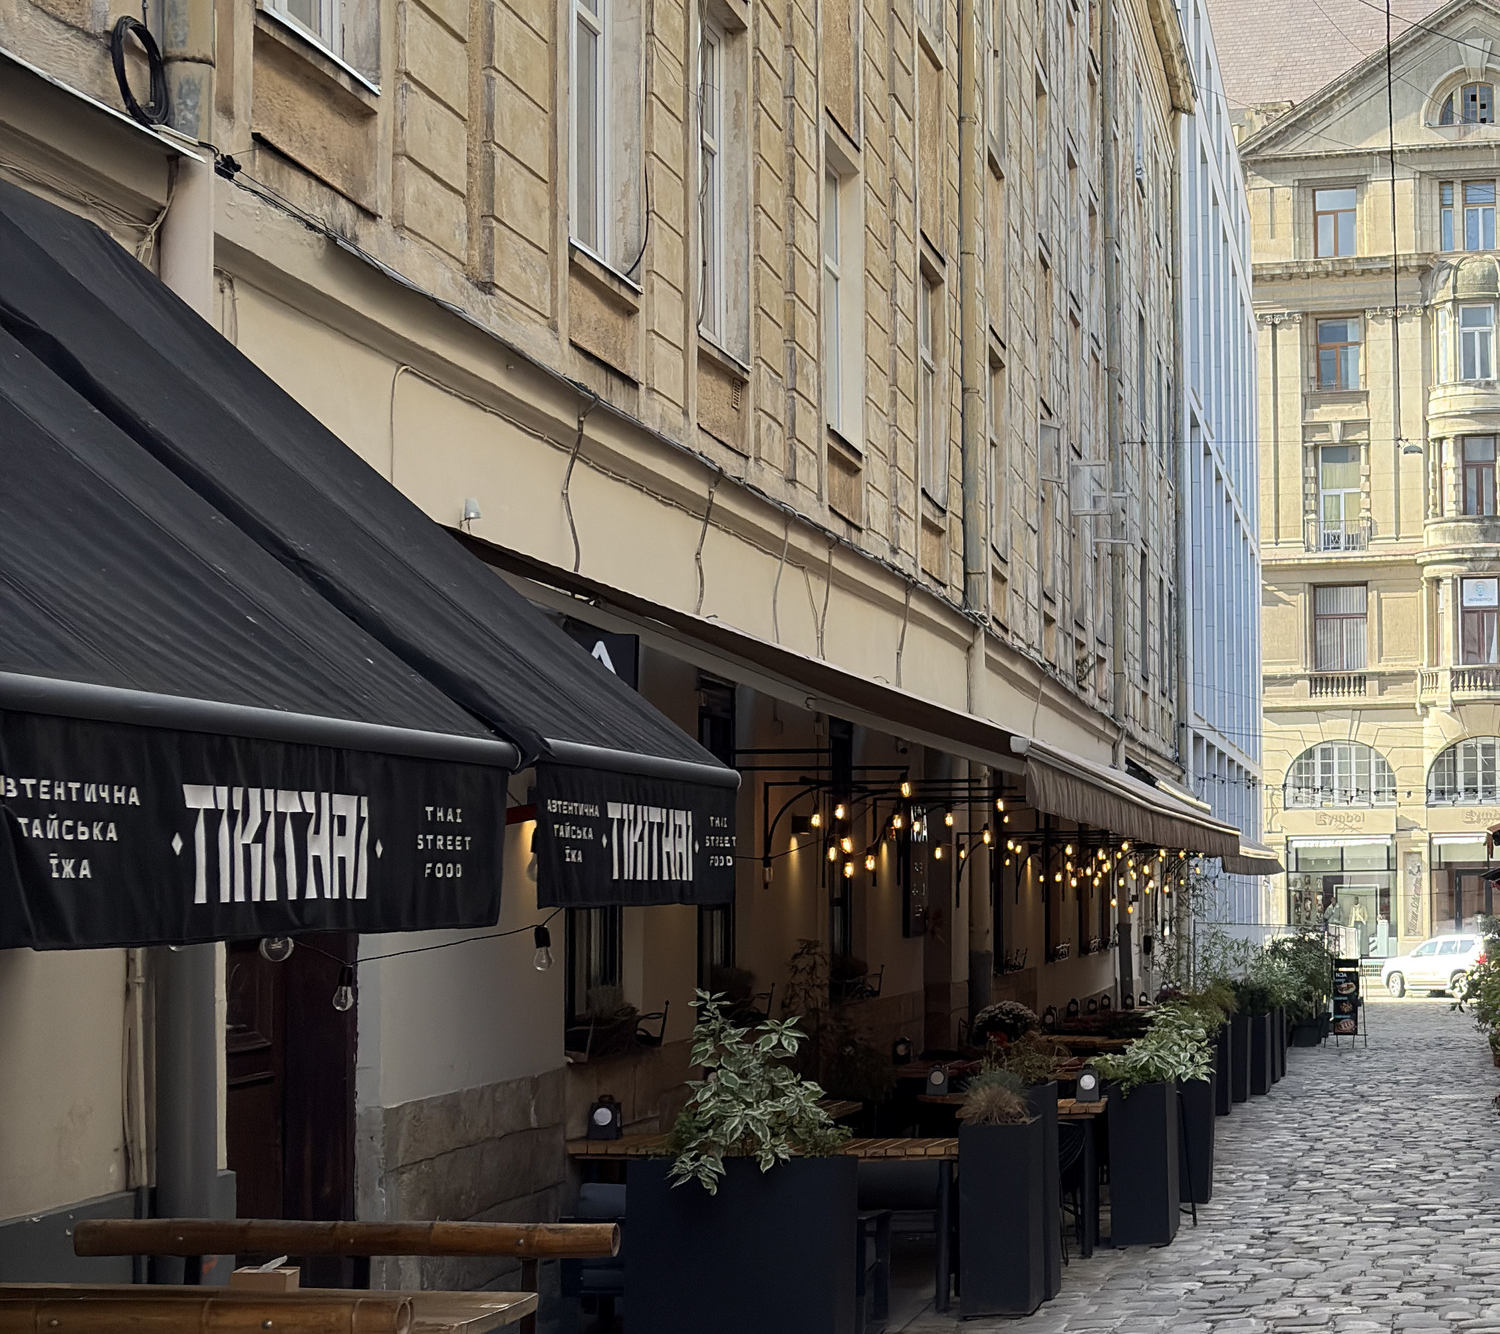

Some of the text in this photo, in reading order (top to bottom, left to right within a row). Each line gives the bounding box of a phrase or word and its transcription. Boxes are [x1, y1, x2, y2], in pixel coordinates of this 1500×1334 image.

[425, 806, 463, 823] THAI
[709, 816, 728, 828] THAI
[17, 813, 118, 842] ТАЙСЬКА
[553, 822, 594, 840] ТАЙСЬКА
[182, 784, 369, 904] TIKITHAI
[417, 834, 472, 851] STREET
[607, 802, 694, 882] TIKITHAI
[705, 835, 737, 848] STREET
[49, 853, 92, 879] ЇЖА
[710, 855, 734, 867] FOOD
[424, 863, 463, 878] FOOD
